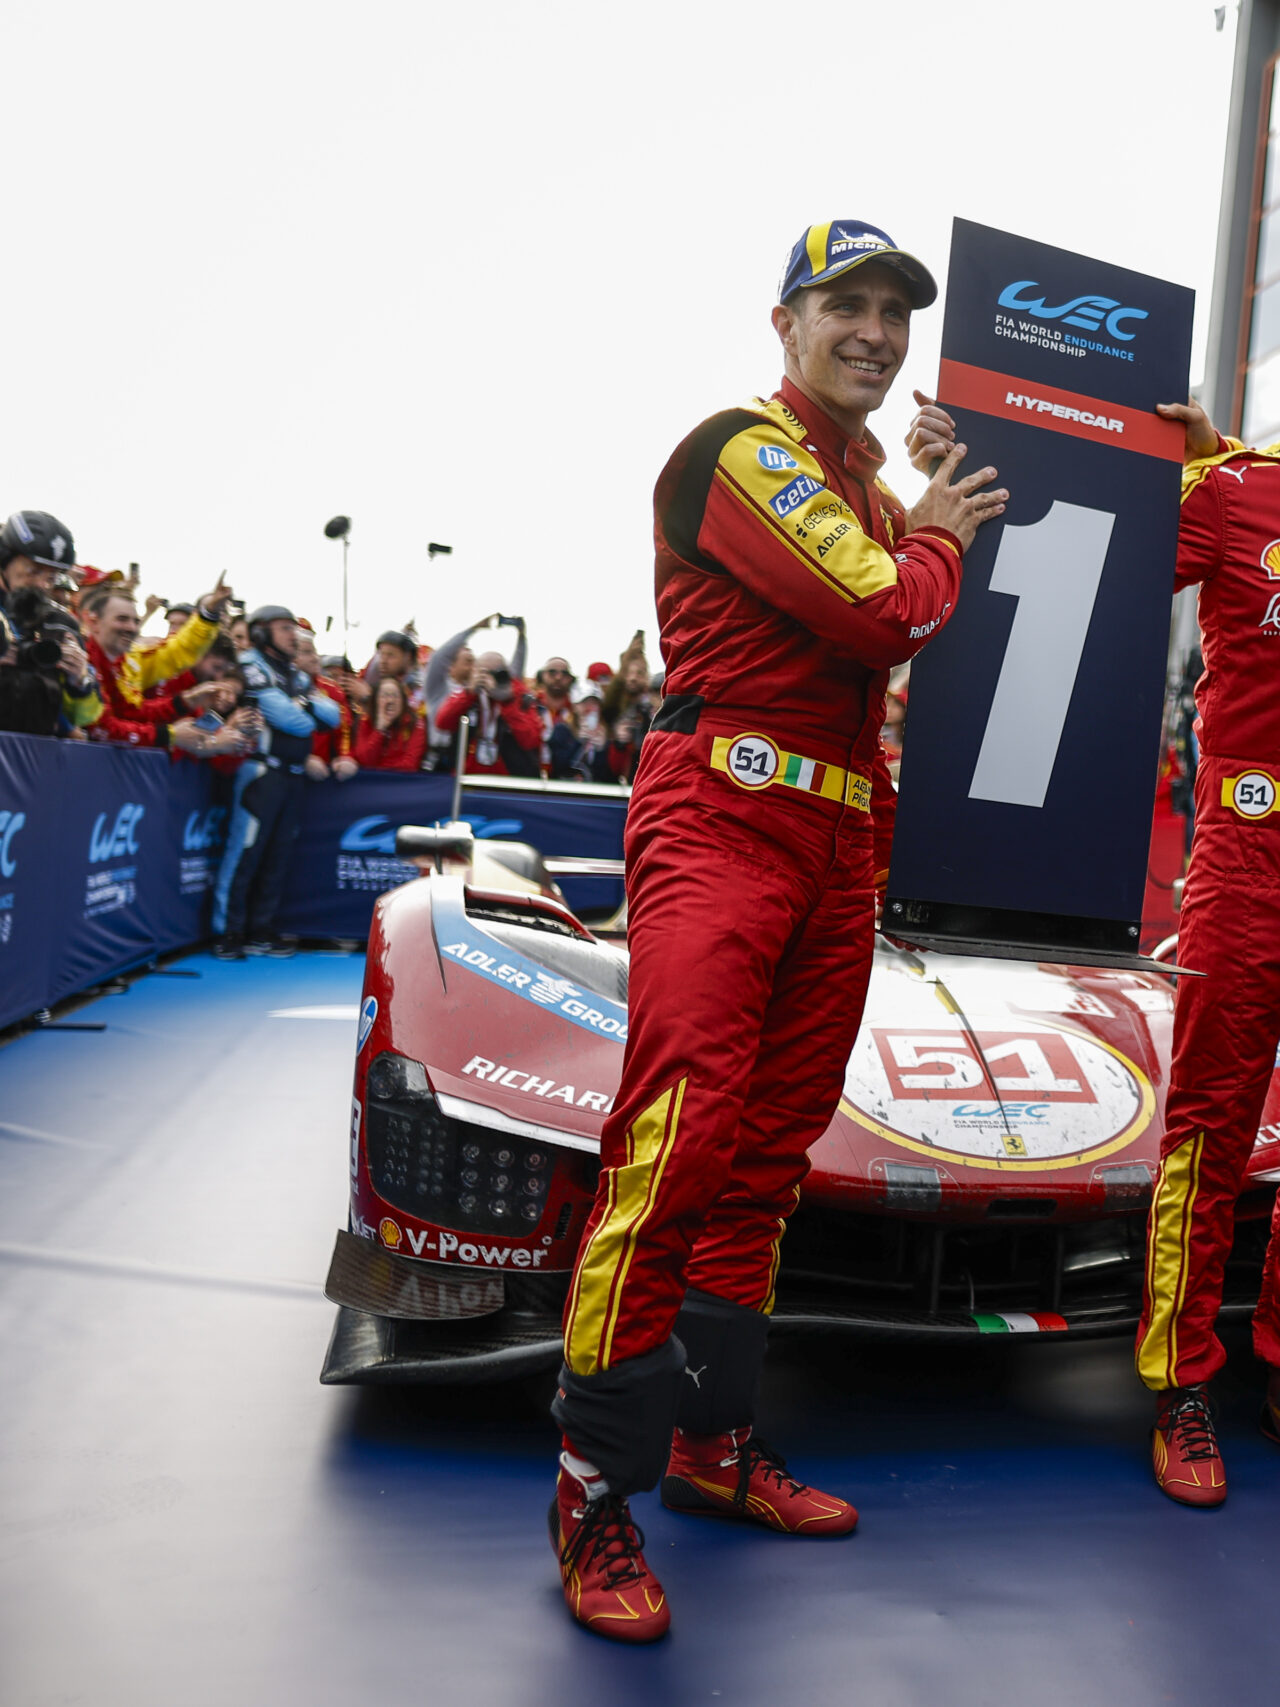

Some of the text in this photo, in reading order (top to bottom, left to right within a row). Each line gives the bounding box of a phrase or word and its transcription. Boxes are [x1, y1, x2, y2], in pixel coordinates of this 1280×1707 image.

[997, 280, 1149, 341] WEC
[994, 325, 1087, 358] CHAMPIONSHIP
[995, 314, 1135, 362] FIA WORLD ENDURANCE
[1005, 391, 1125, 433] HYPERCAR
[815, 522, 851, 559] ADLER
[967, 499, 1117, 808] 1
[734, 746, 769, 777] 51
[1239, 783, 1269, 806] 51
[441, 942, 532, 989] ADLER
[886, 1034, 1084, 1093] 51
[952, 1103, 1050, 1118] WEC
[405, 1228, 549, 1267] V-Power
